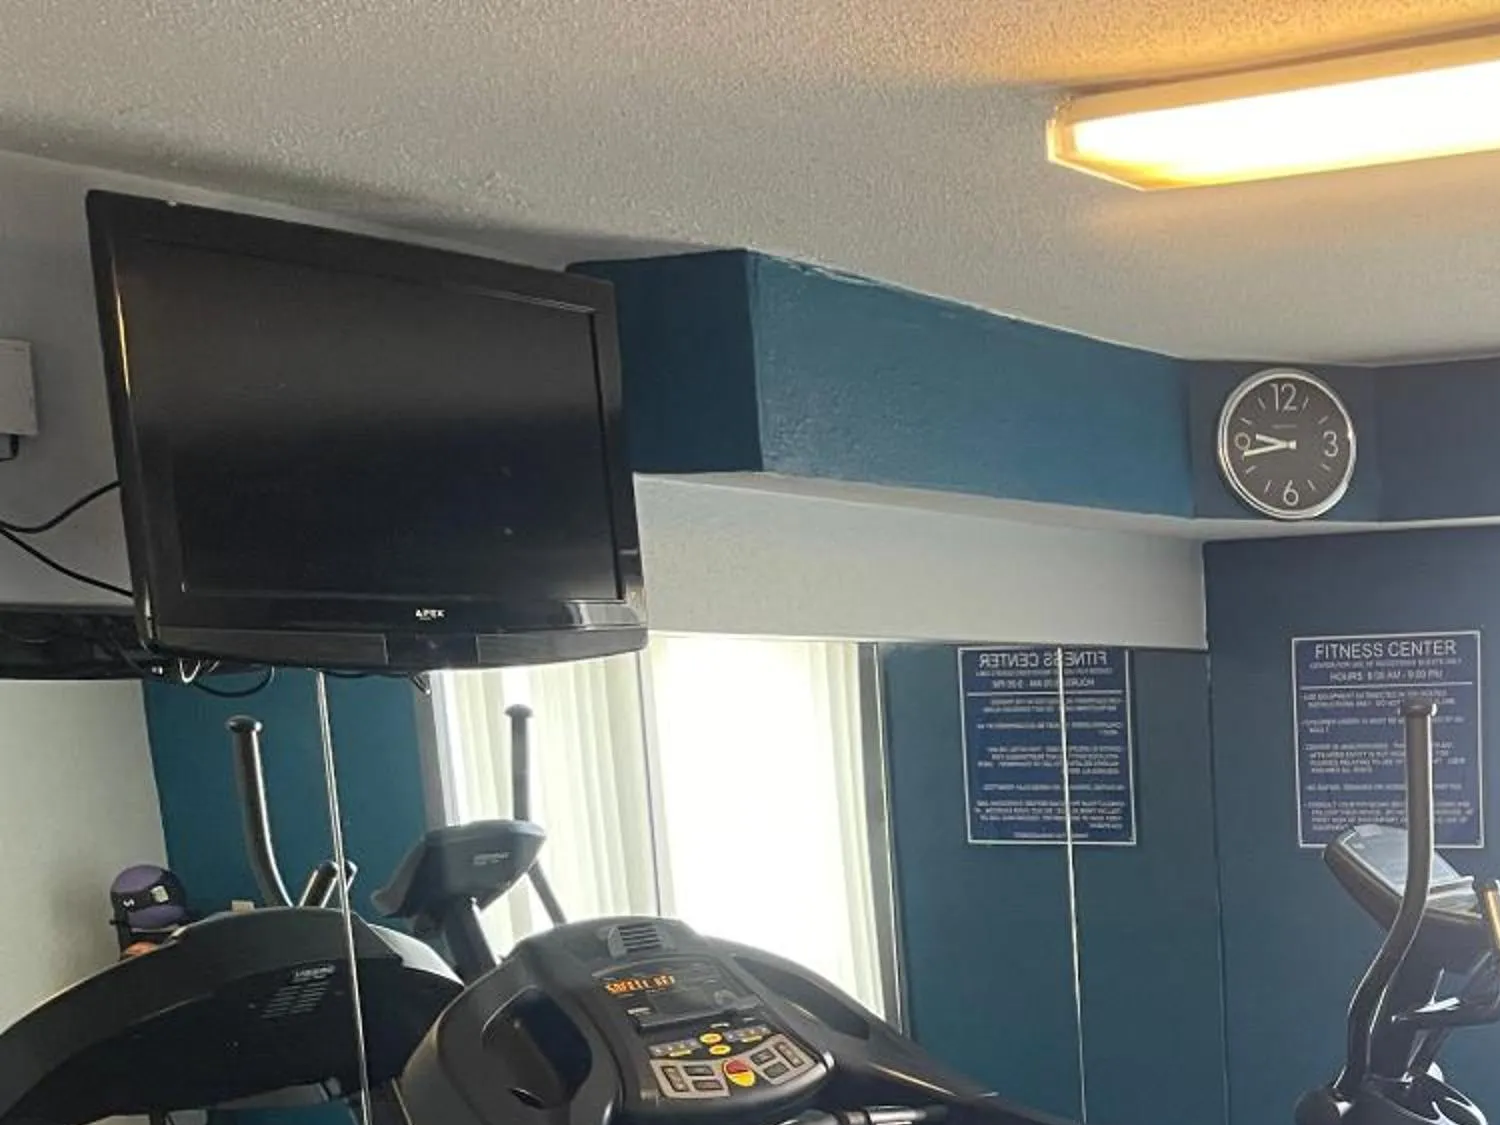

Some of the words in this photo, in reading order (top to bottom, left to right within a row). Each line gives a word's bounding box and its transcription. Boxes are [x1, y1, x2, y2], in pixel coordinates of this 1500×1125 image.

[1270, 383, 1297, 411] 12
[1234, 432, 1251, 461] 9
[1323, 431, 1338, 457] 3
[1283, 480, 1299, 506] 6
[1315, 642, 1384, 660] FITNESS
[1387, 639, 1457, 658] CENTER
